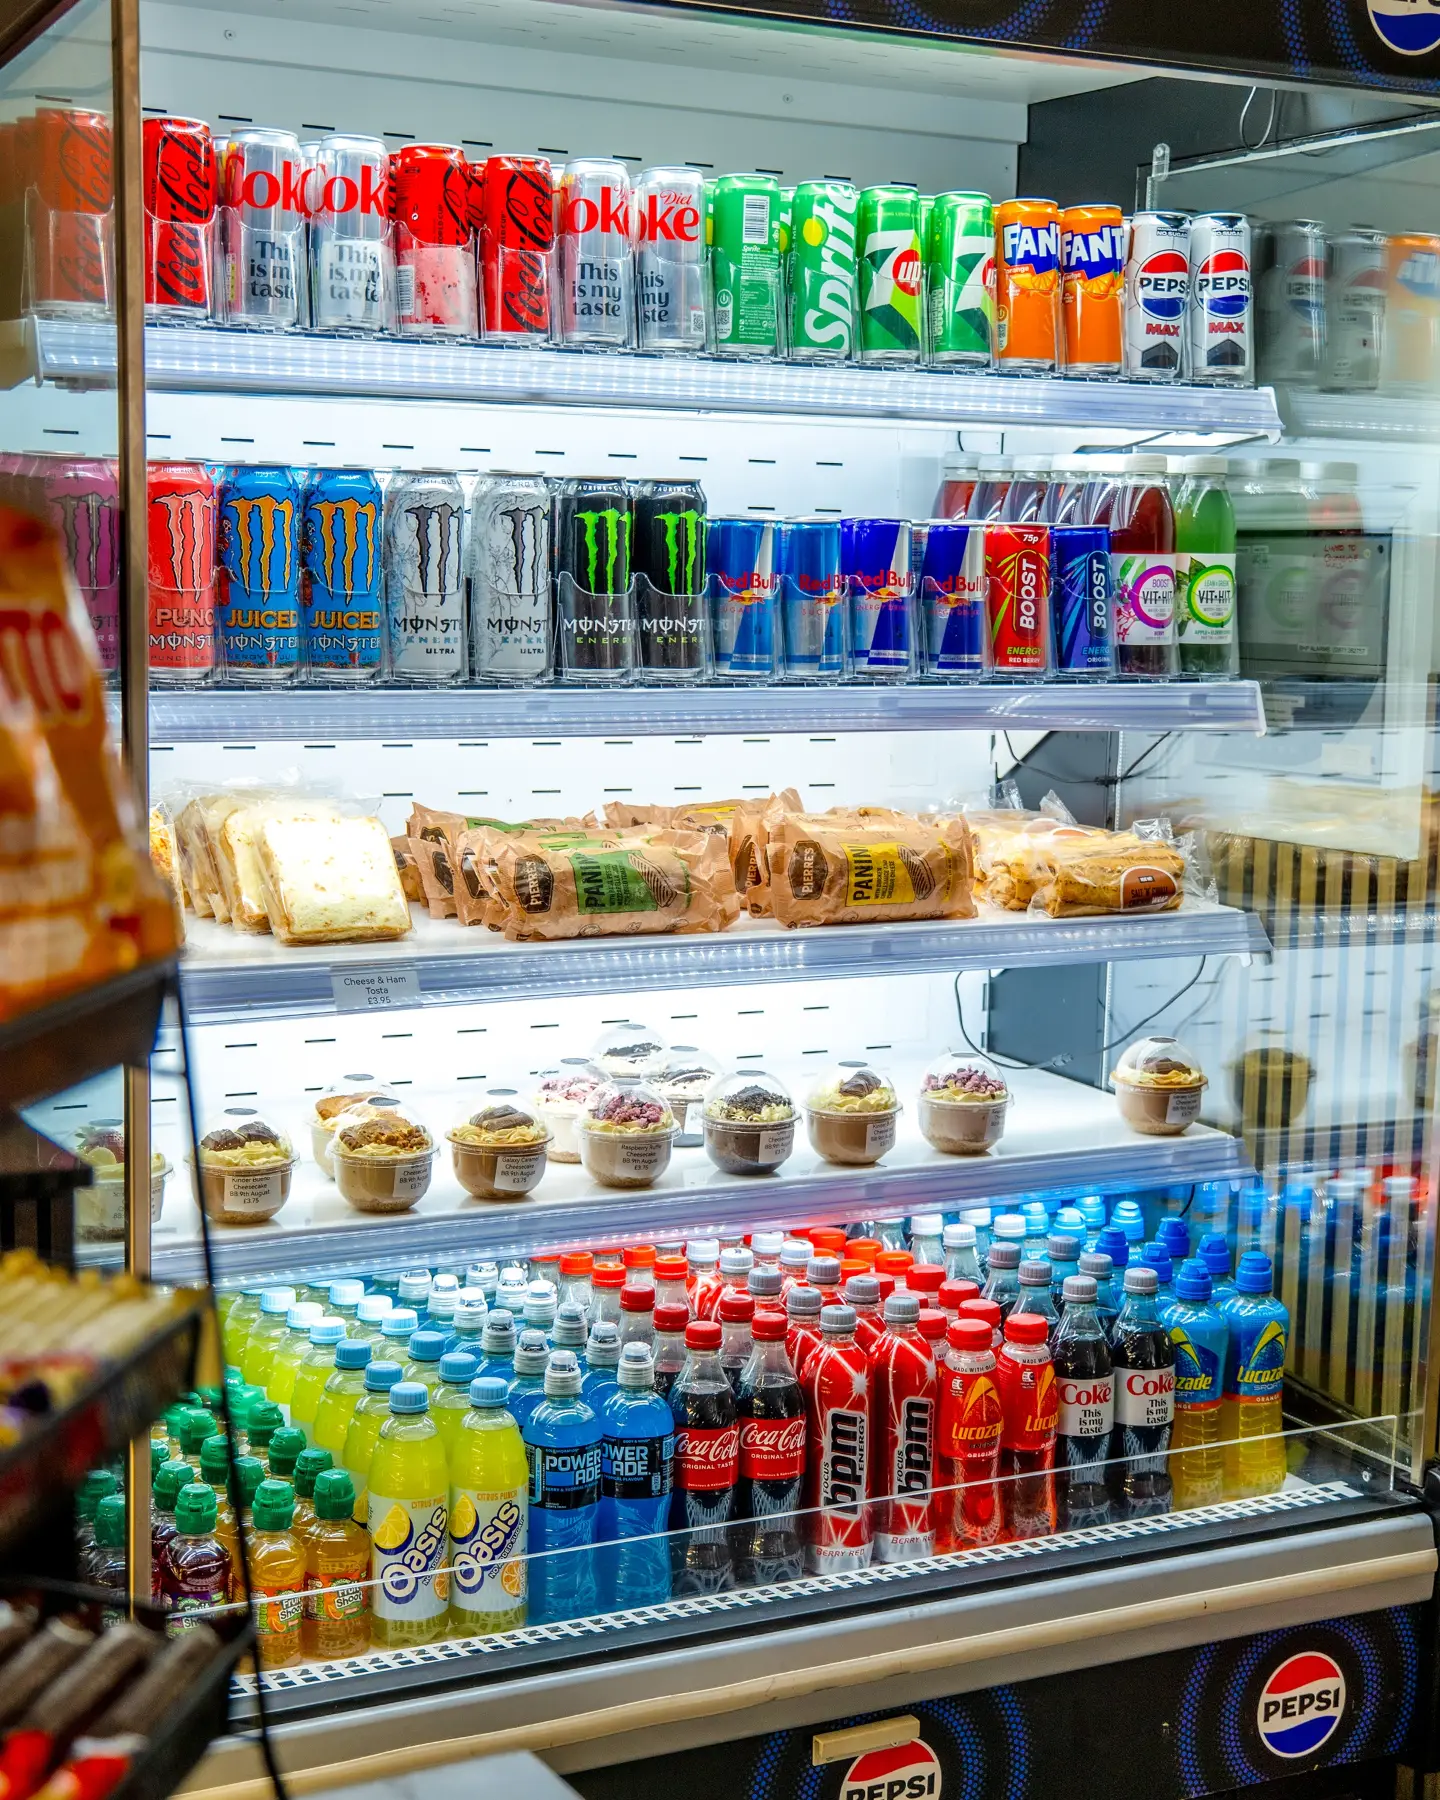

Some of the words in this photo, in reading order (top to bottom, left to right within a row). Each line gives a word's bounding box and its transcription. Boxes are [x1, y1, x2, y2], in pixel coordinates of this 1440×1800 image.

[660, 190, 693, 204] Diet
[1062, 226, 1123, 267] FANT
[250, 259, 267, 278] is
[577, 263, 618, 281] This
[572, 281, 586, 297] is
[591, 284, 621, 301] my
[1140, 277, 1187, 294] PEPS
[573, 302, 621, 317] taste
[1146, 323, 1180, 337] MAX
[1208, 322, 1244, 334] MAX
[1023, 534, 1039, 544] 75p
[800, 573, 831, 590] Red
[956, 576, 982, 592] Bull
[1020, 558, 1037, 630] BOOST
[1093, 559, 1106, 629] BOOST
[1007, 647, 1042, 655] ENERGY
[1083, 647, 1110, 655] ENERG
[344, 977, 375, 986] Cheese
[377, 976, 385, 984] &
[386, 975, 407, 984] Ham
[365, 987, 389, 995] Tosta
[367, 996, 391, 1005] £3.95
[621, 1144, 649, 1152] Raspberry
[240, 1189, 250, 1197] 9th
[251, 1189, 271, 1198] August
[1127, 1374, 1174, 1396] Coke
[1060, 1383, 1112, 1405] Coke
[1149, 1398, 1167, 1408] This
[1082, 1408, 1102, 1418] This
[1146, 1415, 1168, 1424] taste
[1155, 1408, 1168, 1417] my
[1079, 1418, 1087, 1426] is
[1088, 1418, 1103, 1428] my
[1079, 1425, 1103, 1435] taste
[785, 1449, 802, 1458] TASTE
[897, 1401, 930, 1500] bpm
[546, 1450, 600, 1471] POWER
[717, 1460, 734, 1469] TASTE
[822, 1412, 862, 1516] bpm
[896, 1450, 904, 1483] FOCUS
[822, 1461, 830, 1495] FOCUS
[476, 1493, 499, 1501] CITRUS
[500, 1490, 518, 1500] PUNCH
[411, 1500, 432, 1509] CITRUS
[454, 1502, 519, 1588] Oasis
[891, 1536, 920, 1544] BERRY
[383, 1507, 448, 1598] Oasis
[816, 1547, 845, 1556] BERRY
[848, 1548, 865, 1557] RED
[489, 1567, 500, 1579] NO
[335, 1592, 362, 1607] Shoot
[1263, 1686, 1341, 1723] PEPSI
